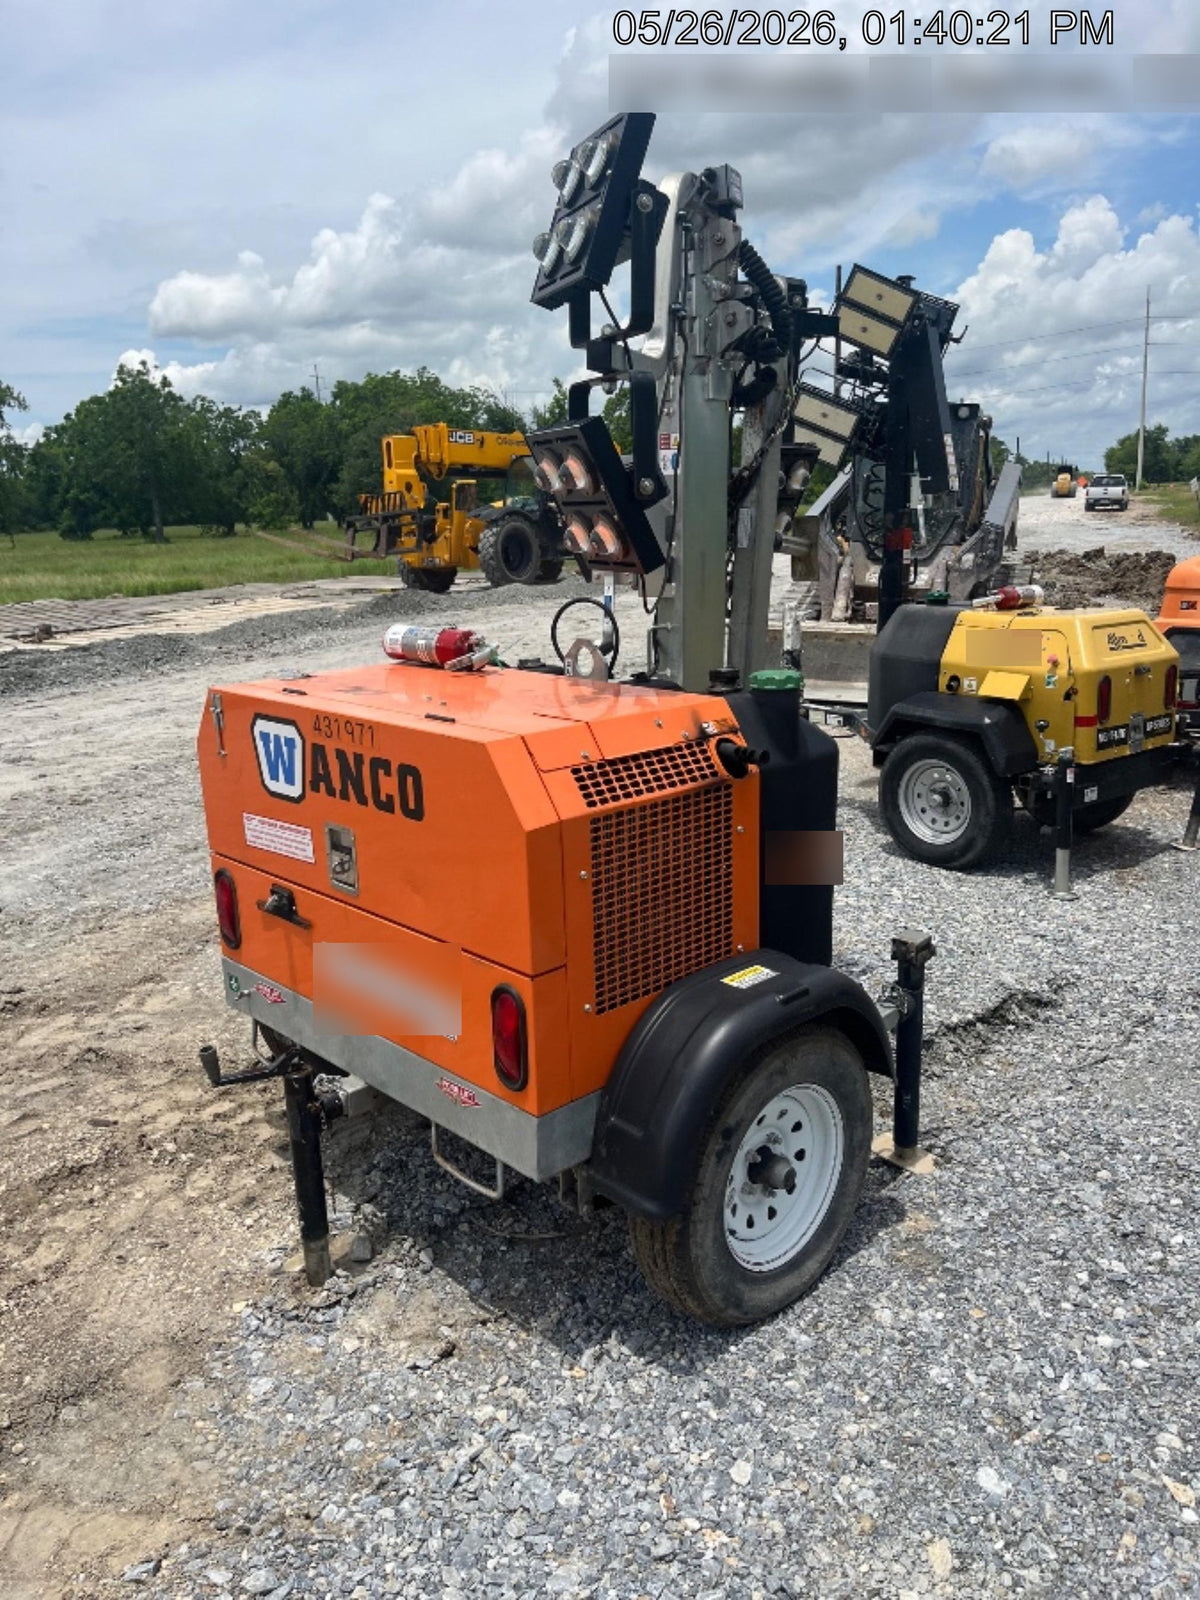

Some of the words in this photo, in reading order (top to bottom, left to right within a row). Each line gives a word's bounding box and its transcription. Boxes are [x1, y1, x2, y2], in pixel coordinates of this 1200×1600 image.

[448, 431, 474, 444] JCB
[312, 714, 377, 748] 431971
[259, 730, 425, 822] WANCO
